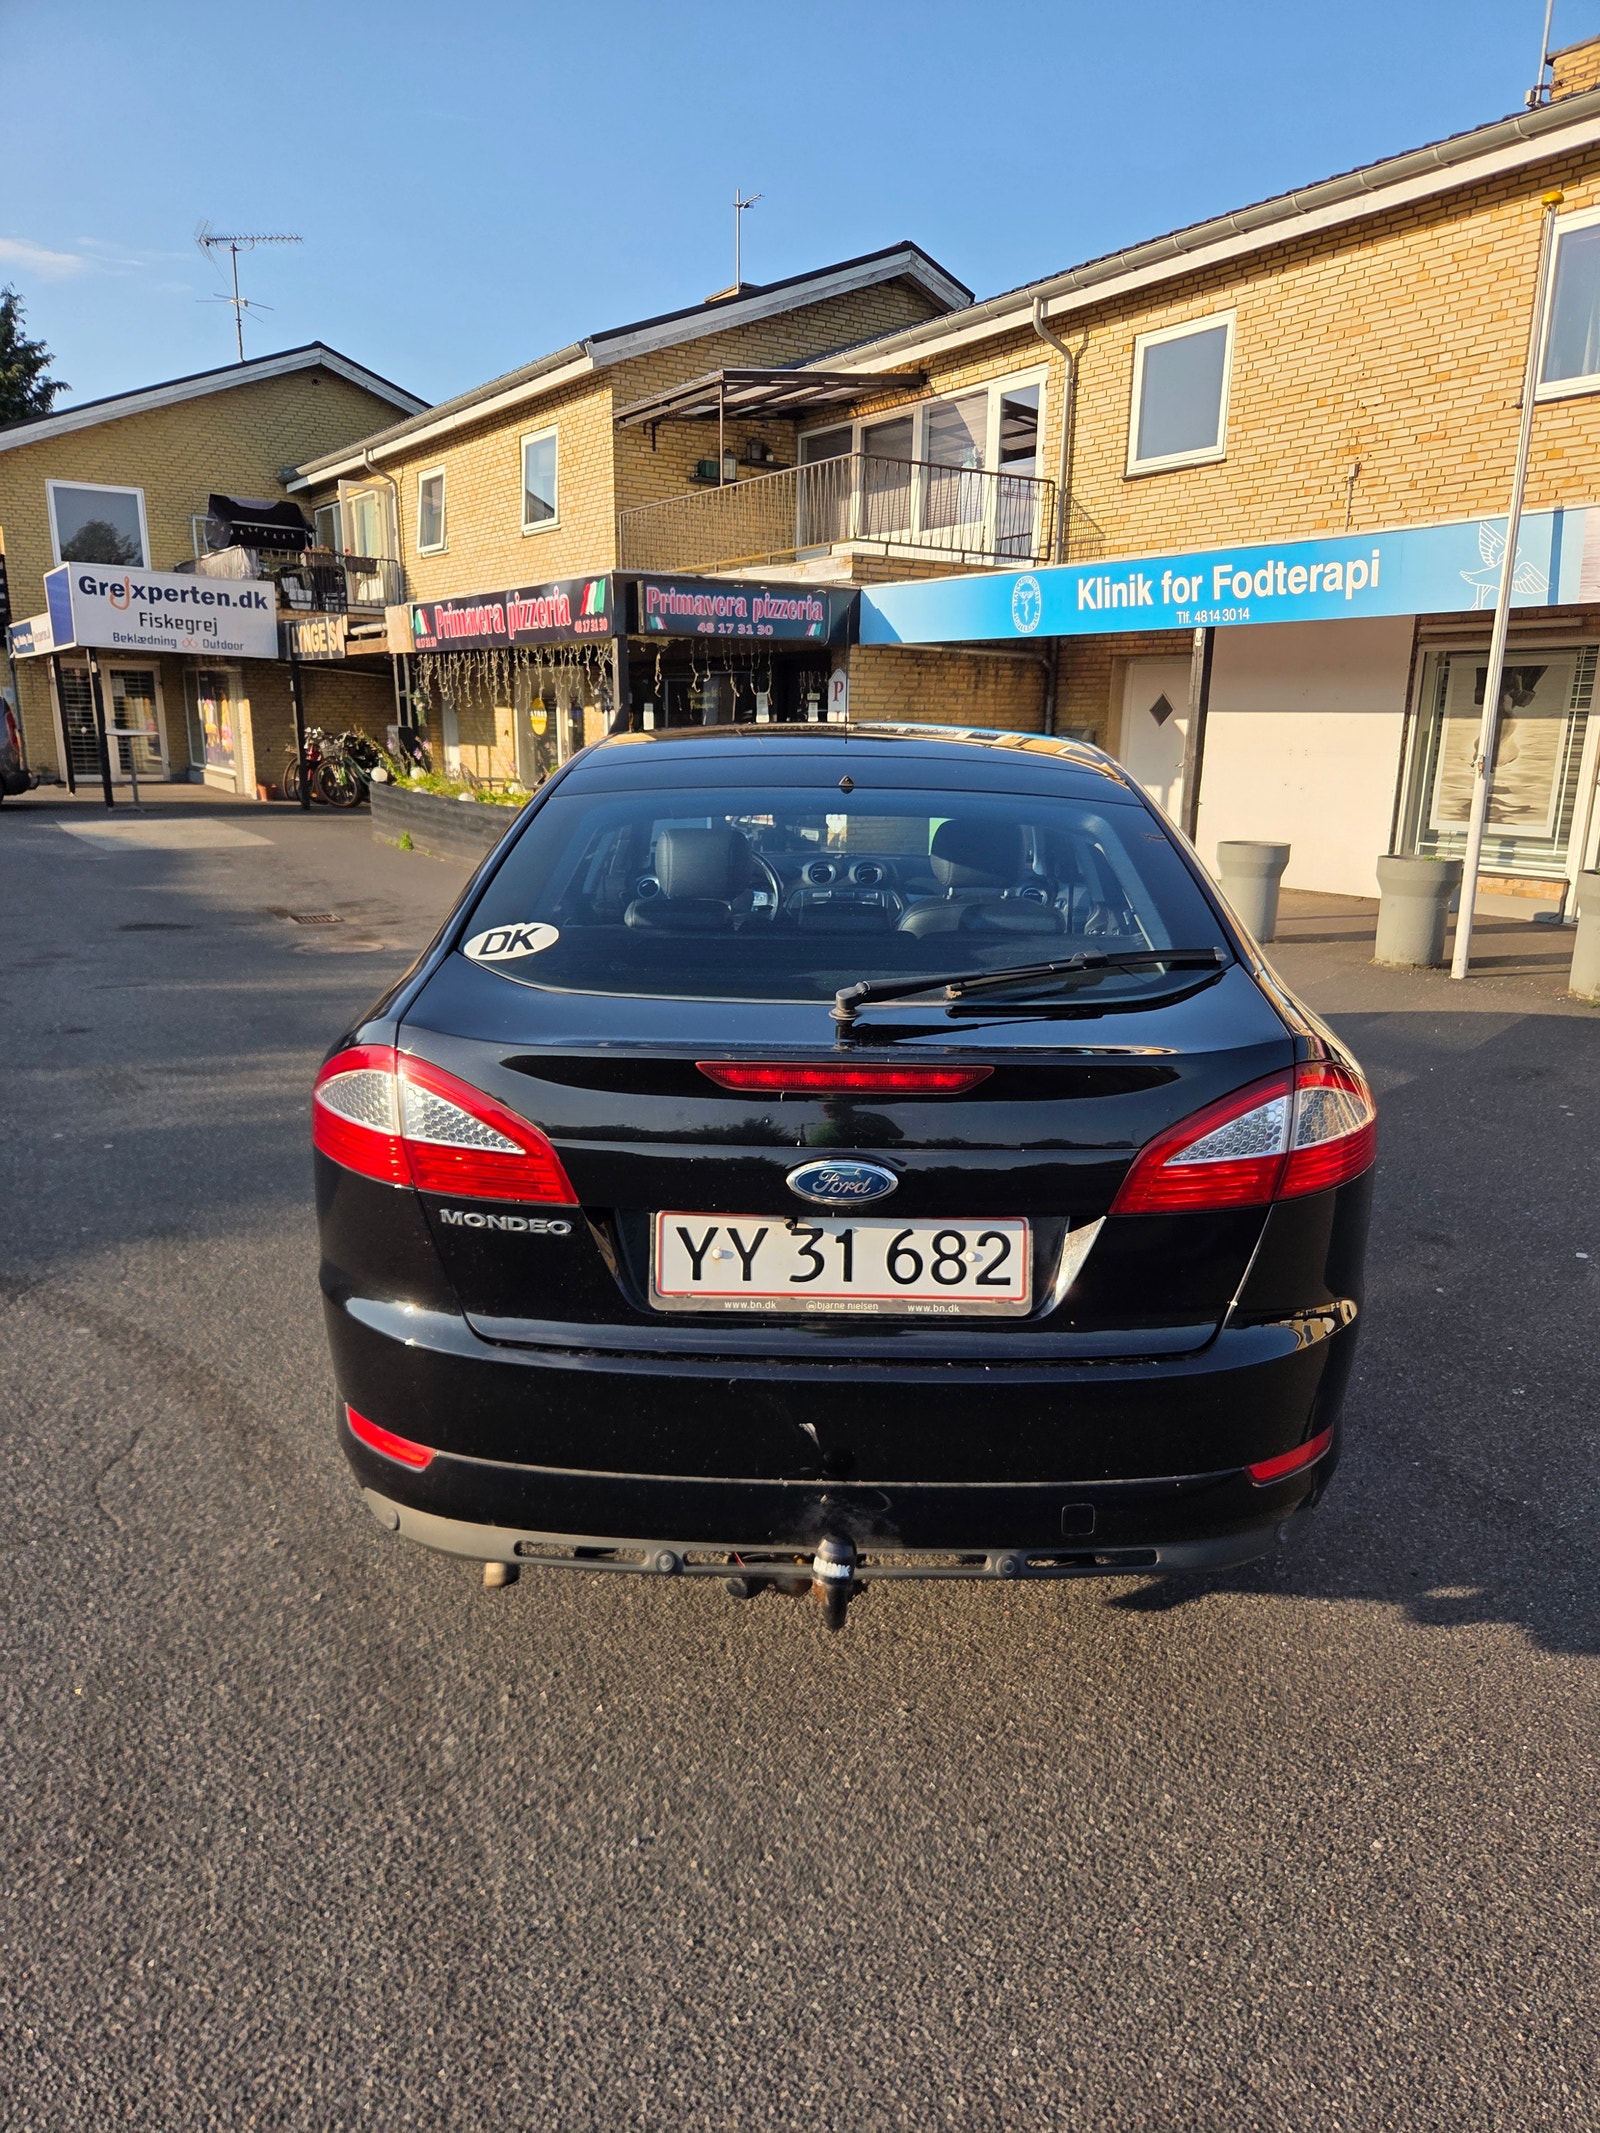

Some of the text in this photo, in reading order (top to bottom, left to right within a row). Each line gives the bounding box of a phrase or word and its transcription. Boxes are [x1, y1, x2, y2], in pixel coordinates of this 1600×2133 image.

[1077, 573, 1154, 611] Klinik
[1162, 569, 1203, 604] for
[1213, 549, 1380, 600] Fodterapi
[434, 585, 572, 640] Primavera pizzeria
[646, 586, 823, 624] Primavera pizzeria
[1176, 610, 1192, 624] Tlf.
[138, 611, 218, 637] Fiskegrej
[291, 622, 328, 653] LYNGE
[697, 621, 774, 636] 48 17 31 30
[112, 631, 245, 651] Beklædning Outdoor
[478, 926, 543, 955] DK
[812, 1167, 873, 1194] Ford
[439, 1208, 573, 1235] MONDEO
[676, 1226, 1012, 1286] YY 31 682
[724, 1300, 960, 1313] www.bn.dk bjarne nielsen www.bn.dk
